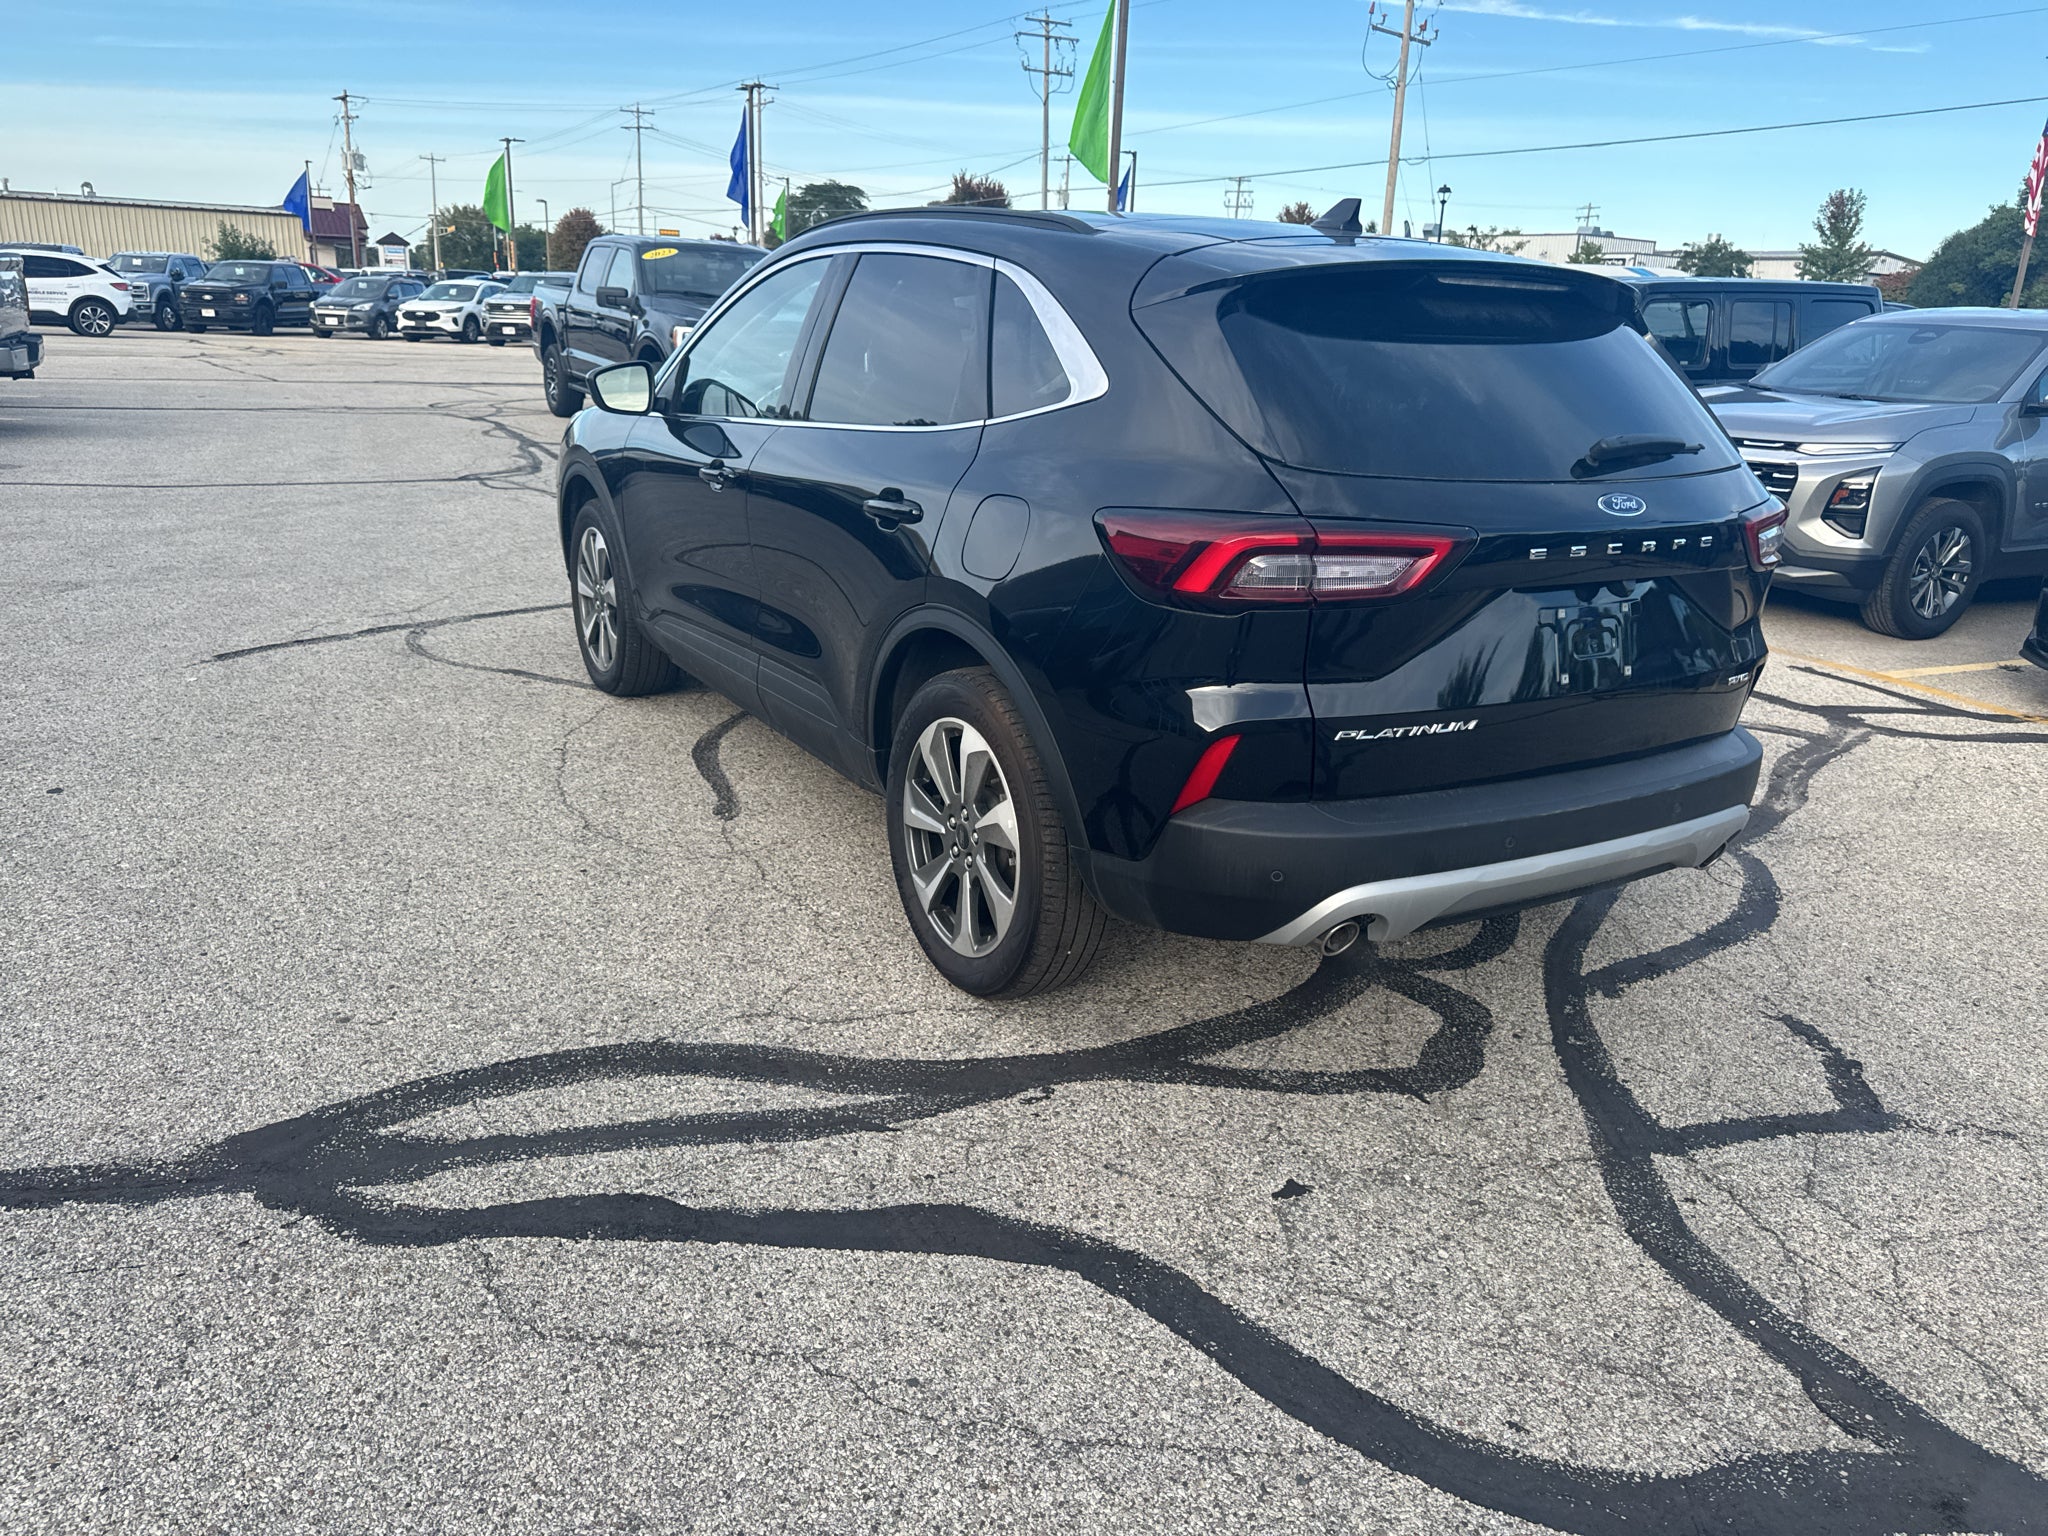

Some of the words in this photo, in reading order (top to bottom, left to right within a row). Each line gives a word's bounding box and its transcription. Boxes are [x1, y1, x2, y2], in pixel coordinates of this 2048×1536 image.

[1612, 495, 1638, 510] Ford
[1529, 535, 1713, 560] ESCAPE
[1334, 719, 1479, 741] PLATINUM
